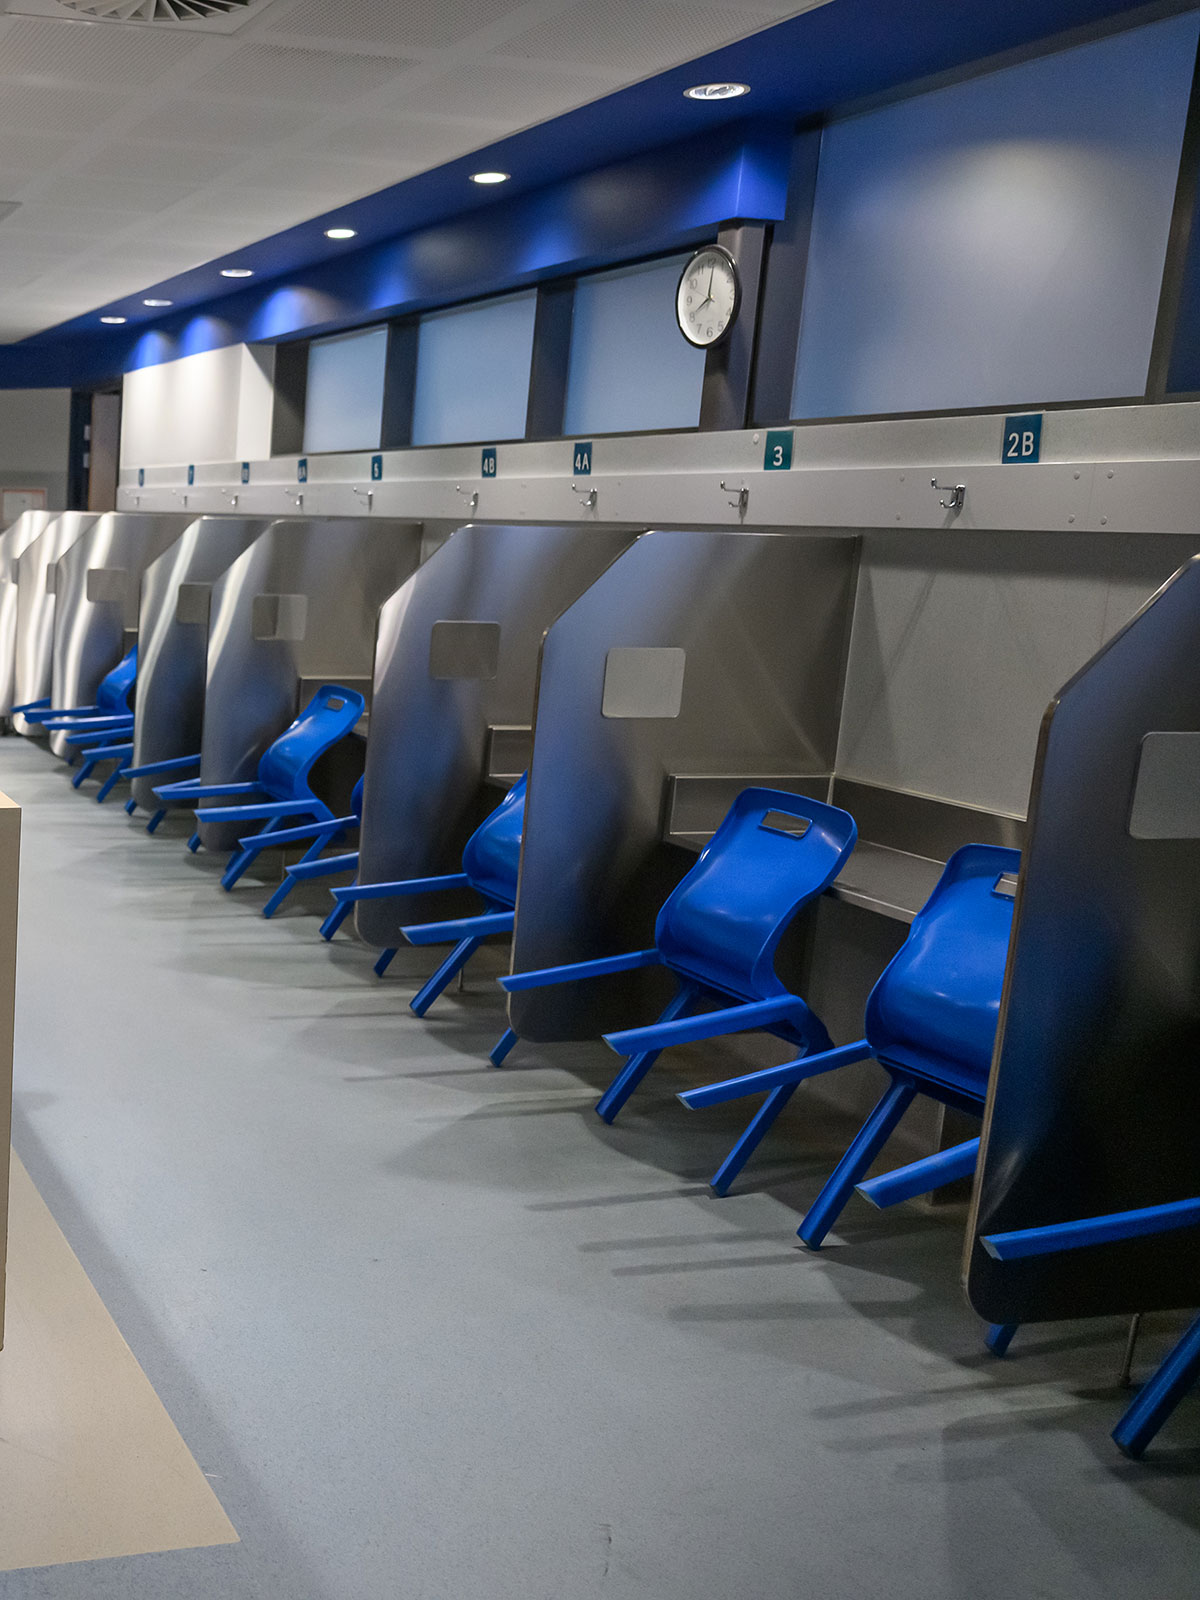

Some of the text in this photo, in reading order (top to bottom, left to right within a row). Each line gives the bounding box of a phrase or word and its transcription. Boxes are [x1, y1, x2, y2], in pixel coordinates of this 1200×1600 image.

[697, 265, 704, 274] 11
[690, 279, 698, 289] 10
[686, 296, 692, 305] 9
[689, 312, 695, 323] 8
[696, 324, 702, 334] 7
[717, 321, 724, 331] 5
[706, 327, 713, 337] 6
[1007, 431, 1035, 457] 2B
[772, 446, 783, 466] 3
[483, 458, 495, 474] 4B
[575, 452, 590, 471] 4A
[373, 462, 379, 478] 5
